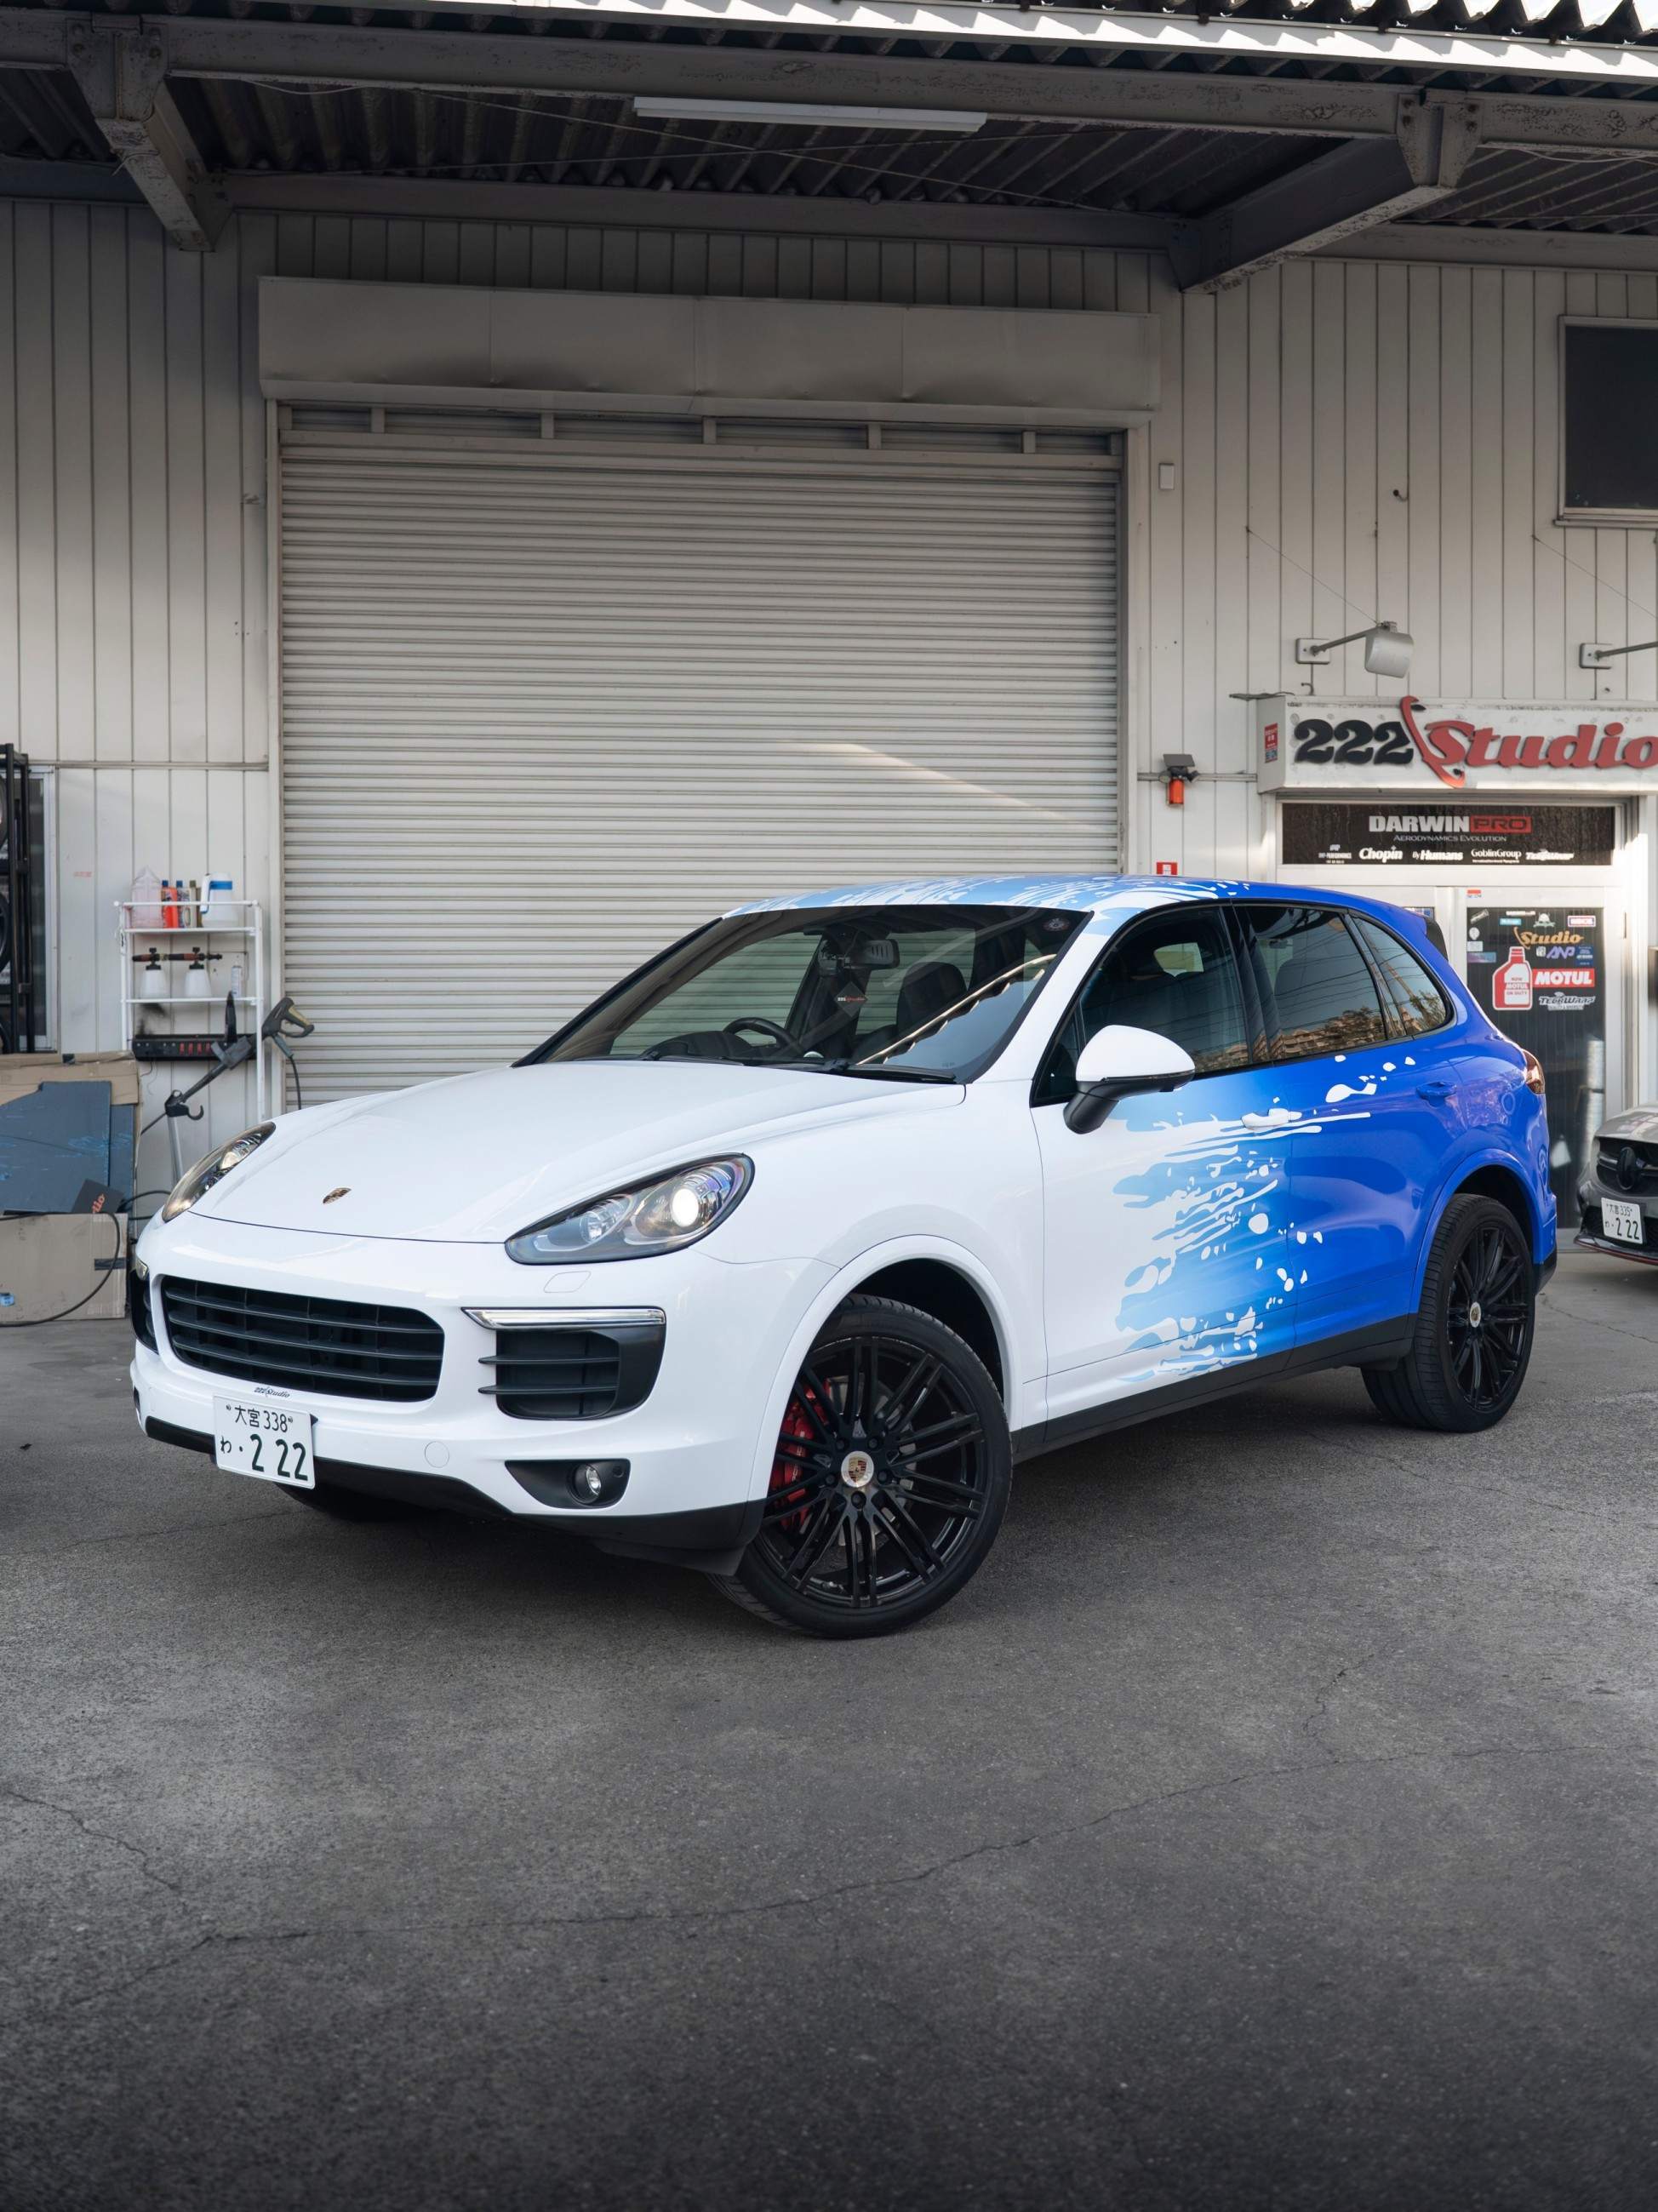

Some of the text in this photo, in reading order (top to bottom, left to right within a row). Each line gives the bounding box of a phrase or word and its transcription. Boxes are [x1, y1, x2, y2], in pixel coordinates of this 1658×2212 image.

[1294, 718, 1414, 764] 222
[1419, 717, 1658, 769] Studio
[1359, 847, 1404, 863] Chopin
[1421, 849, 1464, 861] Humans
[1471, 849, 1522, 860] GoblinGroup
[1519, 930, 1584, 944] Studio
[1535, 971, 1592, 986] MOTUL
[234, 1404, 289, 1433] 大宮 338
[220, 1436, 232, 1454] わ
